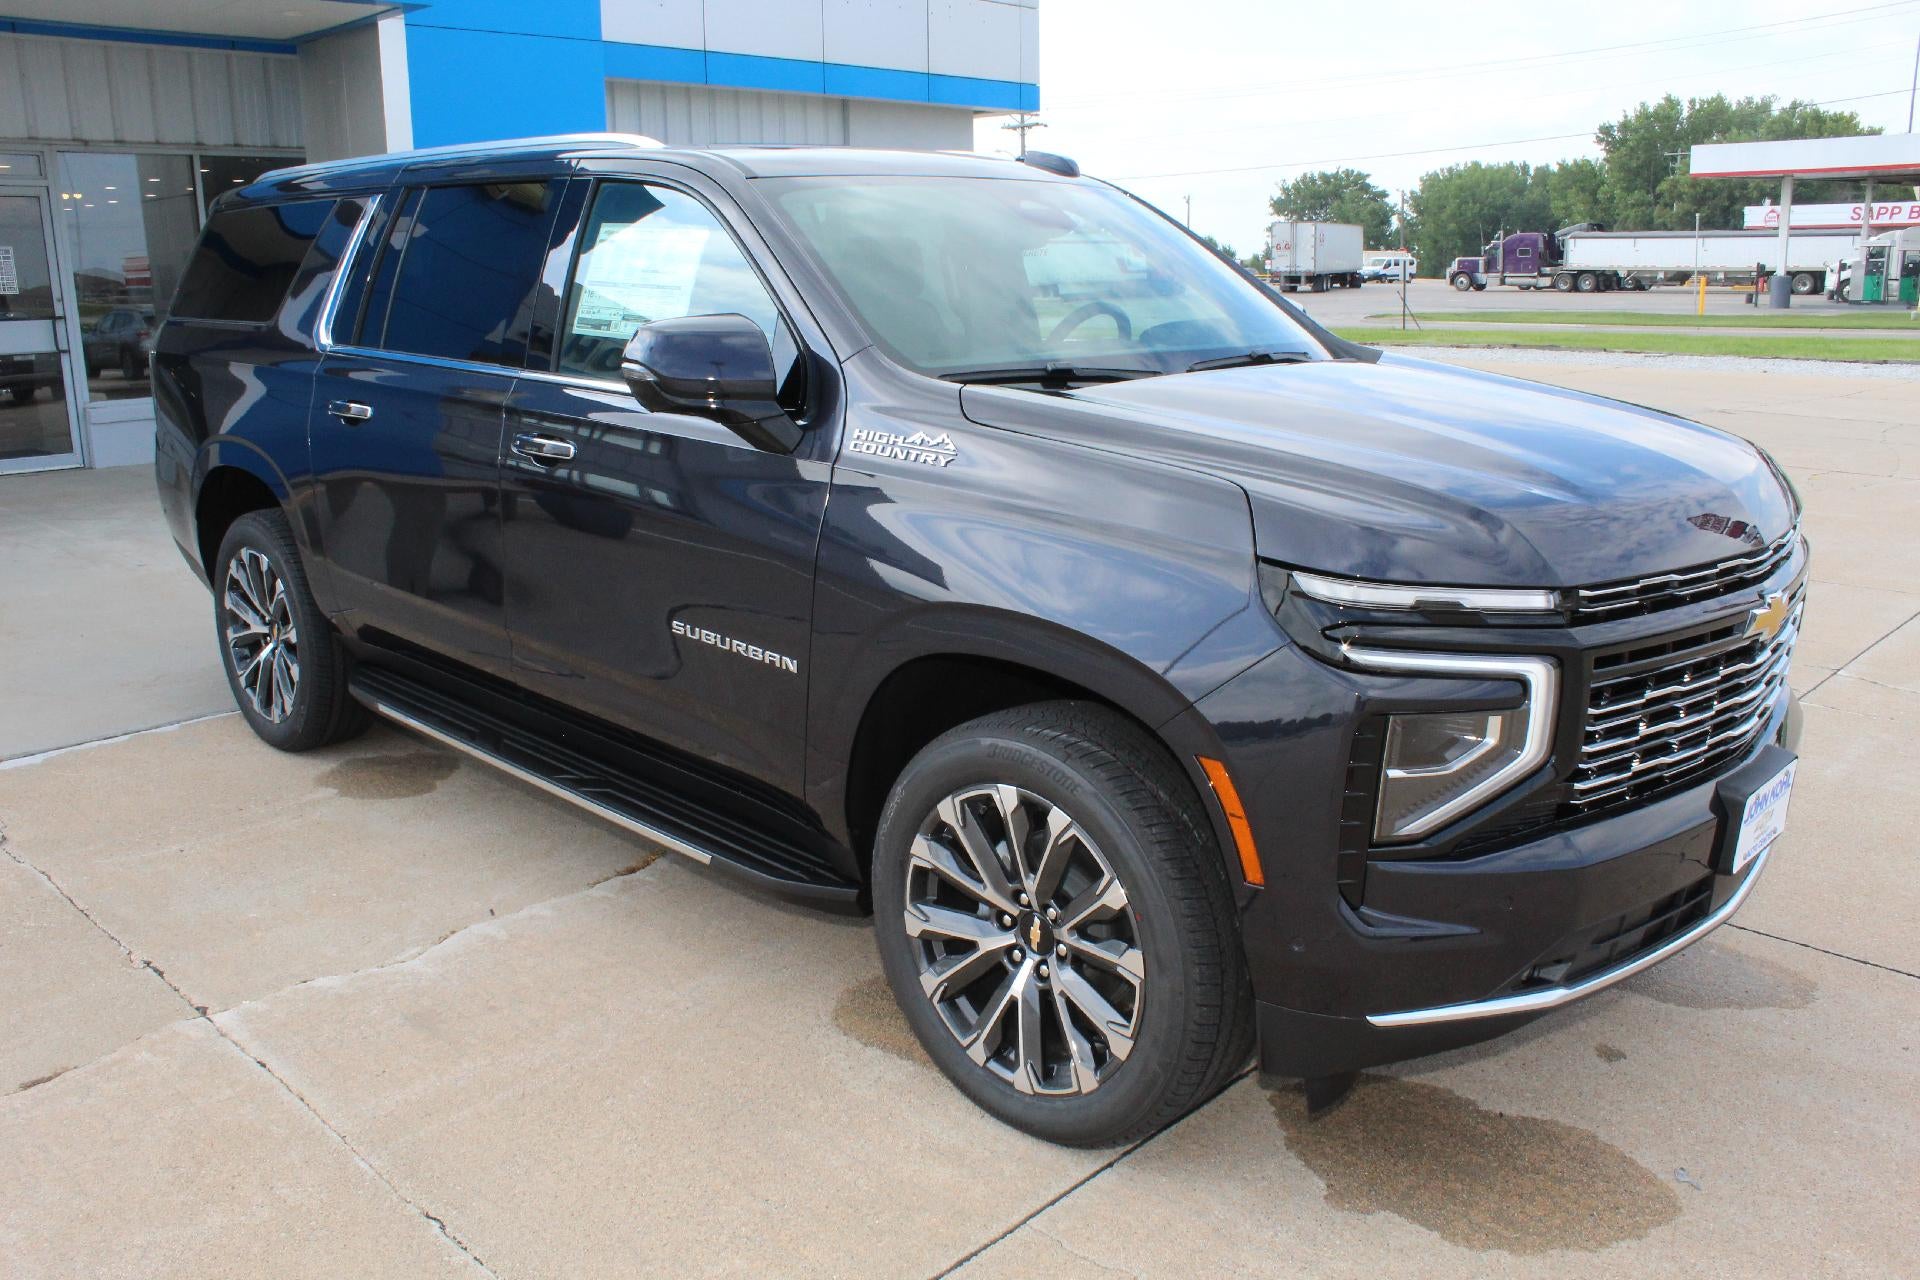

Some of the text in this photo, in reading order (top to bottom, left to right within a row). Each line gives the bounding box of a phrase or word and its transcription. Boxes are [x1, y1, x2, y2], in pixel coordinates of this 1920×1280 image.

[849, 440, 957, 467] COUNTRY
[853, 428, 905, 445] HIGH
[671, 620, 798, 674] SUBURBAN
[987, 742, 1081, 796] BRIDGESTONE
[1743, 791, 1769, 825] JOHN
